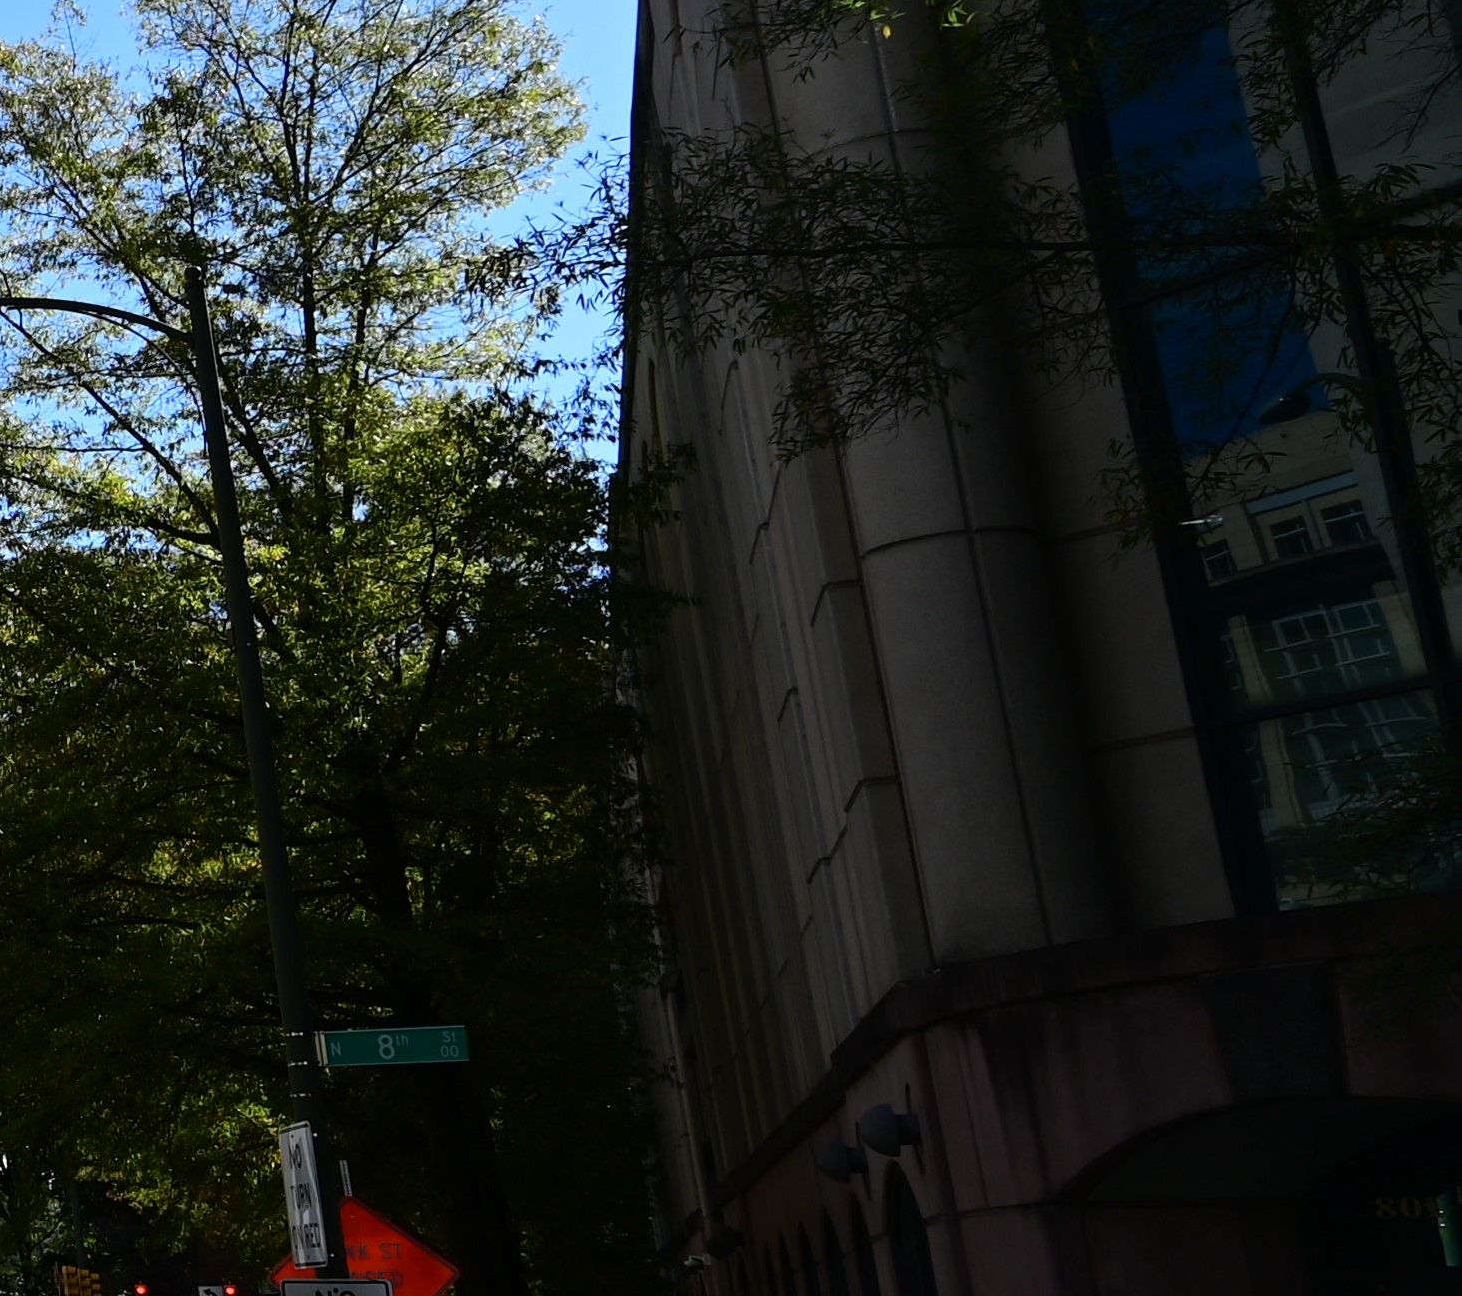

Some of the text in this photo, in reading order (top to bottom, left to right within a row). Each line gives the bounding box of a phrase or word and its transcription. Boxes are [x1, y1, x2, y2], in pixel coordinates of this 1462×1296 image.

[330, 1030, 457, 1060] N 8th St
[440, 1045, 459, 1058] 00
[288, 1143, 302, 1170] NO
[290, 1182, 313, 1209] TURN
[303, 1222, 321, 1249] RED
